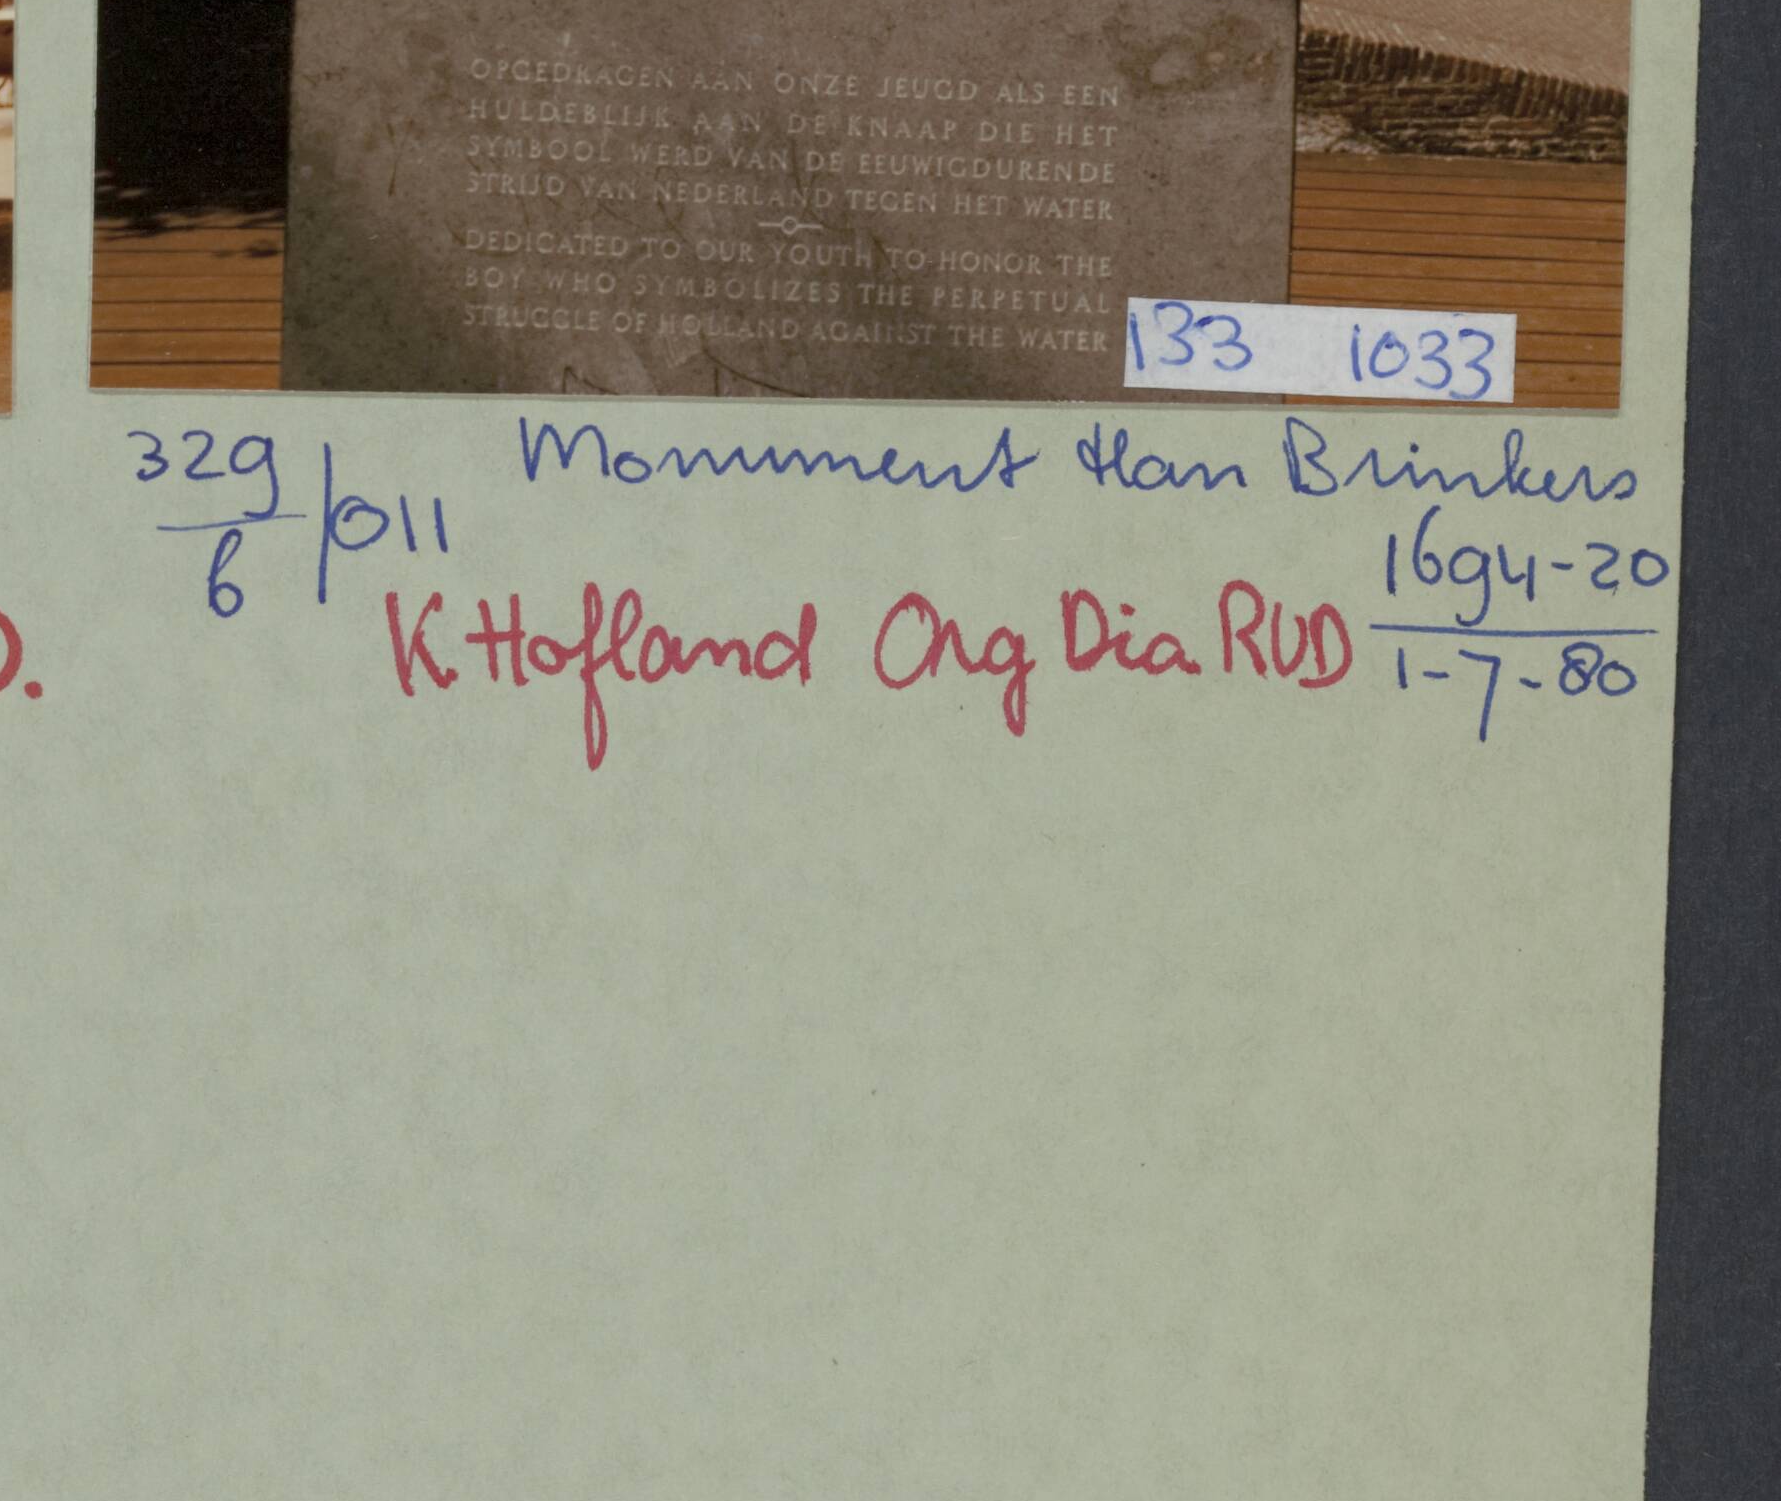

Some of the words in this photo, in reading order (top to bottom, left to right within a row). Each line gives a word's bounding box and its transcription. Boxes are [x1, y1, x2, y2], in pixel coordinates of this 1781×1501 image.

[471, 58, 673, 88] OPGEDRAGEN
[691, 69, 752, 91] AAN
[775, 72, 859, 97] ONZE
[876, 77, 978, 102] JEUGD
[996, 82, 1045, 105] ALS
[1063, 85, 1118, 107] EEN
[469, 99, 670, 128] HULDEBLIJK
[693, 111, 761, 134] AAN
[787, 113, 826, 136] DE
[847, 115, 957, 141] KNAAP
[978, 120, 1034, 144] DIE
[1056, 124, 1118, 147] HET
[468, 135, 611, 163] SYMBOOL
[631, 142, 713, 167] WERD
[728, 148, 788, 171] VAN
[806, 151, 842, 173] DE
[858, 152, 1115, 184] EEUWIGDURENDE
[467, 171, 564, 197] STRIJD
[579, 175, 636, 201] VAN
[653, 180, 833, 209] NEDERLAND
[845, 188, 937, 214] TEGEN
[953, 194, 1009, 217] HET
[1023, 196, 1114, 221] WATER
[466, 229, 629, 257] DEDICATED
[641, 237, 680, 260] TO
[696, 239, 754, 263] OUR
[771, 243, 872, 269] YOUTH
[886, 248, 925, 272] TO
[939, 249, 1043, 275] HONOR
[1058, 254, 1113, 278] THE
[466, 266, 523, 290] BOY
[547, 270, 616, 294] WHO
[634, 274, 841, 303] SYMBOLIZES
[858, 283, 913, 307] THE
[932, 287, 1110, 315] PERPETUAL
[463, 304, 601, 332] STRUGGLE
[612, 311, 648, 334] OF
[659, 313, 800, 341] HOLLAND
[812, 320, 936, 346] AGAINST
[948, 325, 1004, 348] THE
[1019, 328, 1109, 353] WATER
[1129, 300, 1254, 372] 133
[1350, 323, 1495, 400] 1033
[519, 416, 1041, 493] Monument
[1283, 417, 1638, 501] Brinkers
[1386, 505, 1669, 626] 1694-20
[465, 581, 817, 771] Hofland
[1221, 580, 1353, 690] RUD
